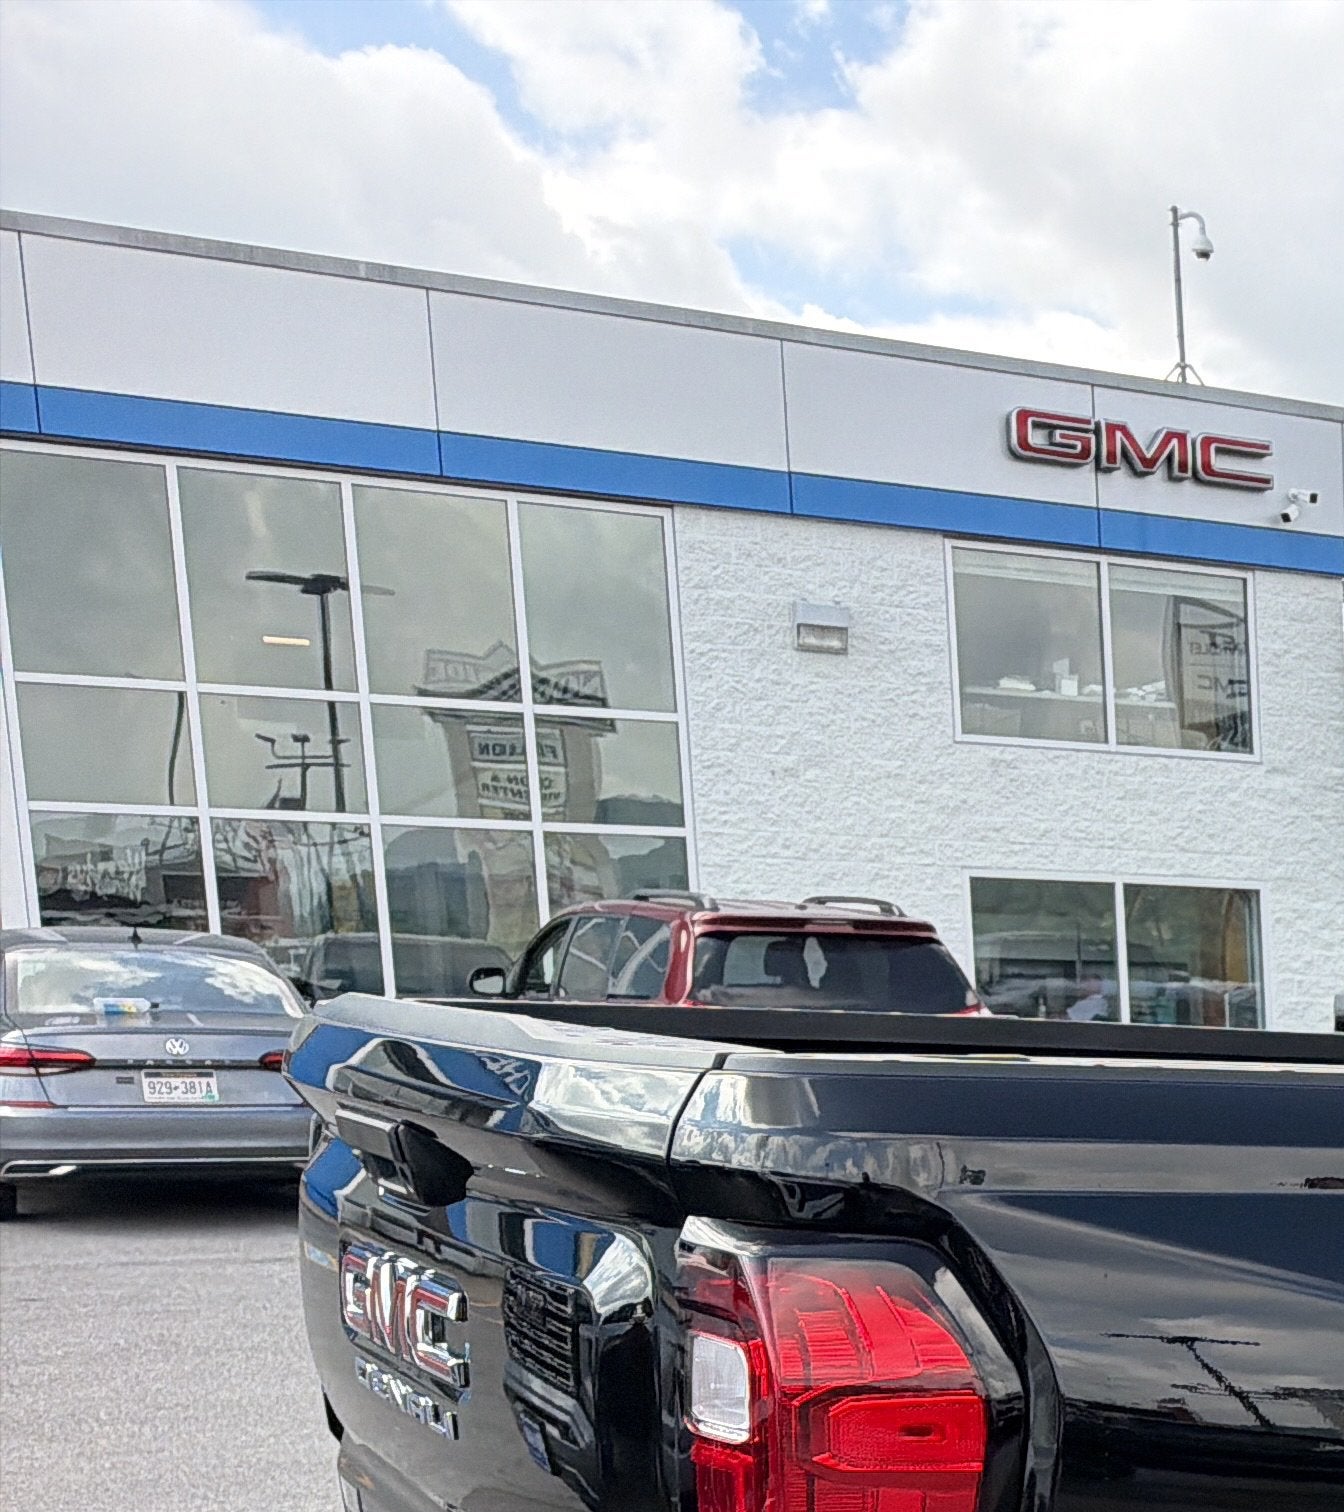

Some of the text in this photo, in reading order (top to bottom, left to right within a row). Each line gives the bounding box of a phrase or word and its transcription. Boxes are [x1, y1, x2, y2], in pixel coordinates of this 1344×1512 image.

[1007, 405, 1274, 490] GMC
[340, 1242, 470, 1389] GMC
[355, 1357, 459, 1440] DENALI
